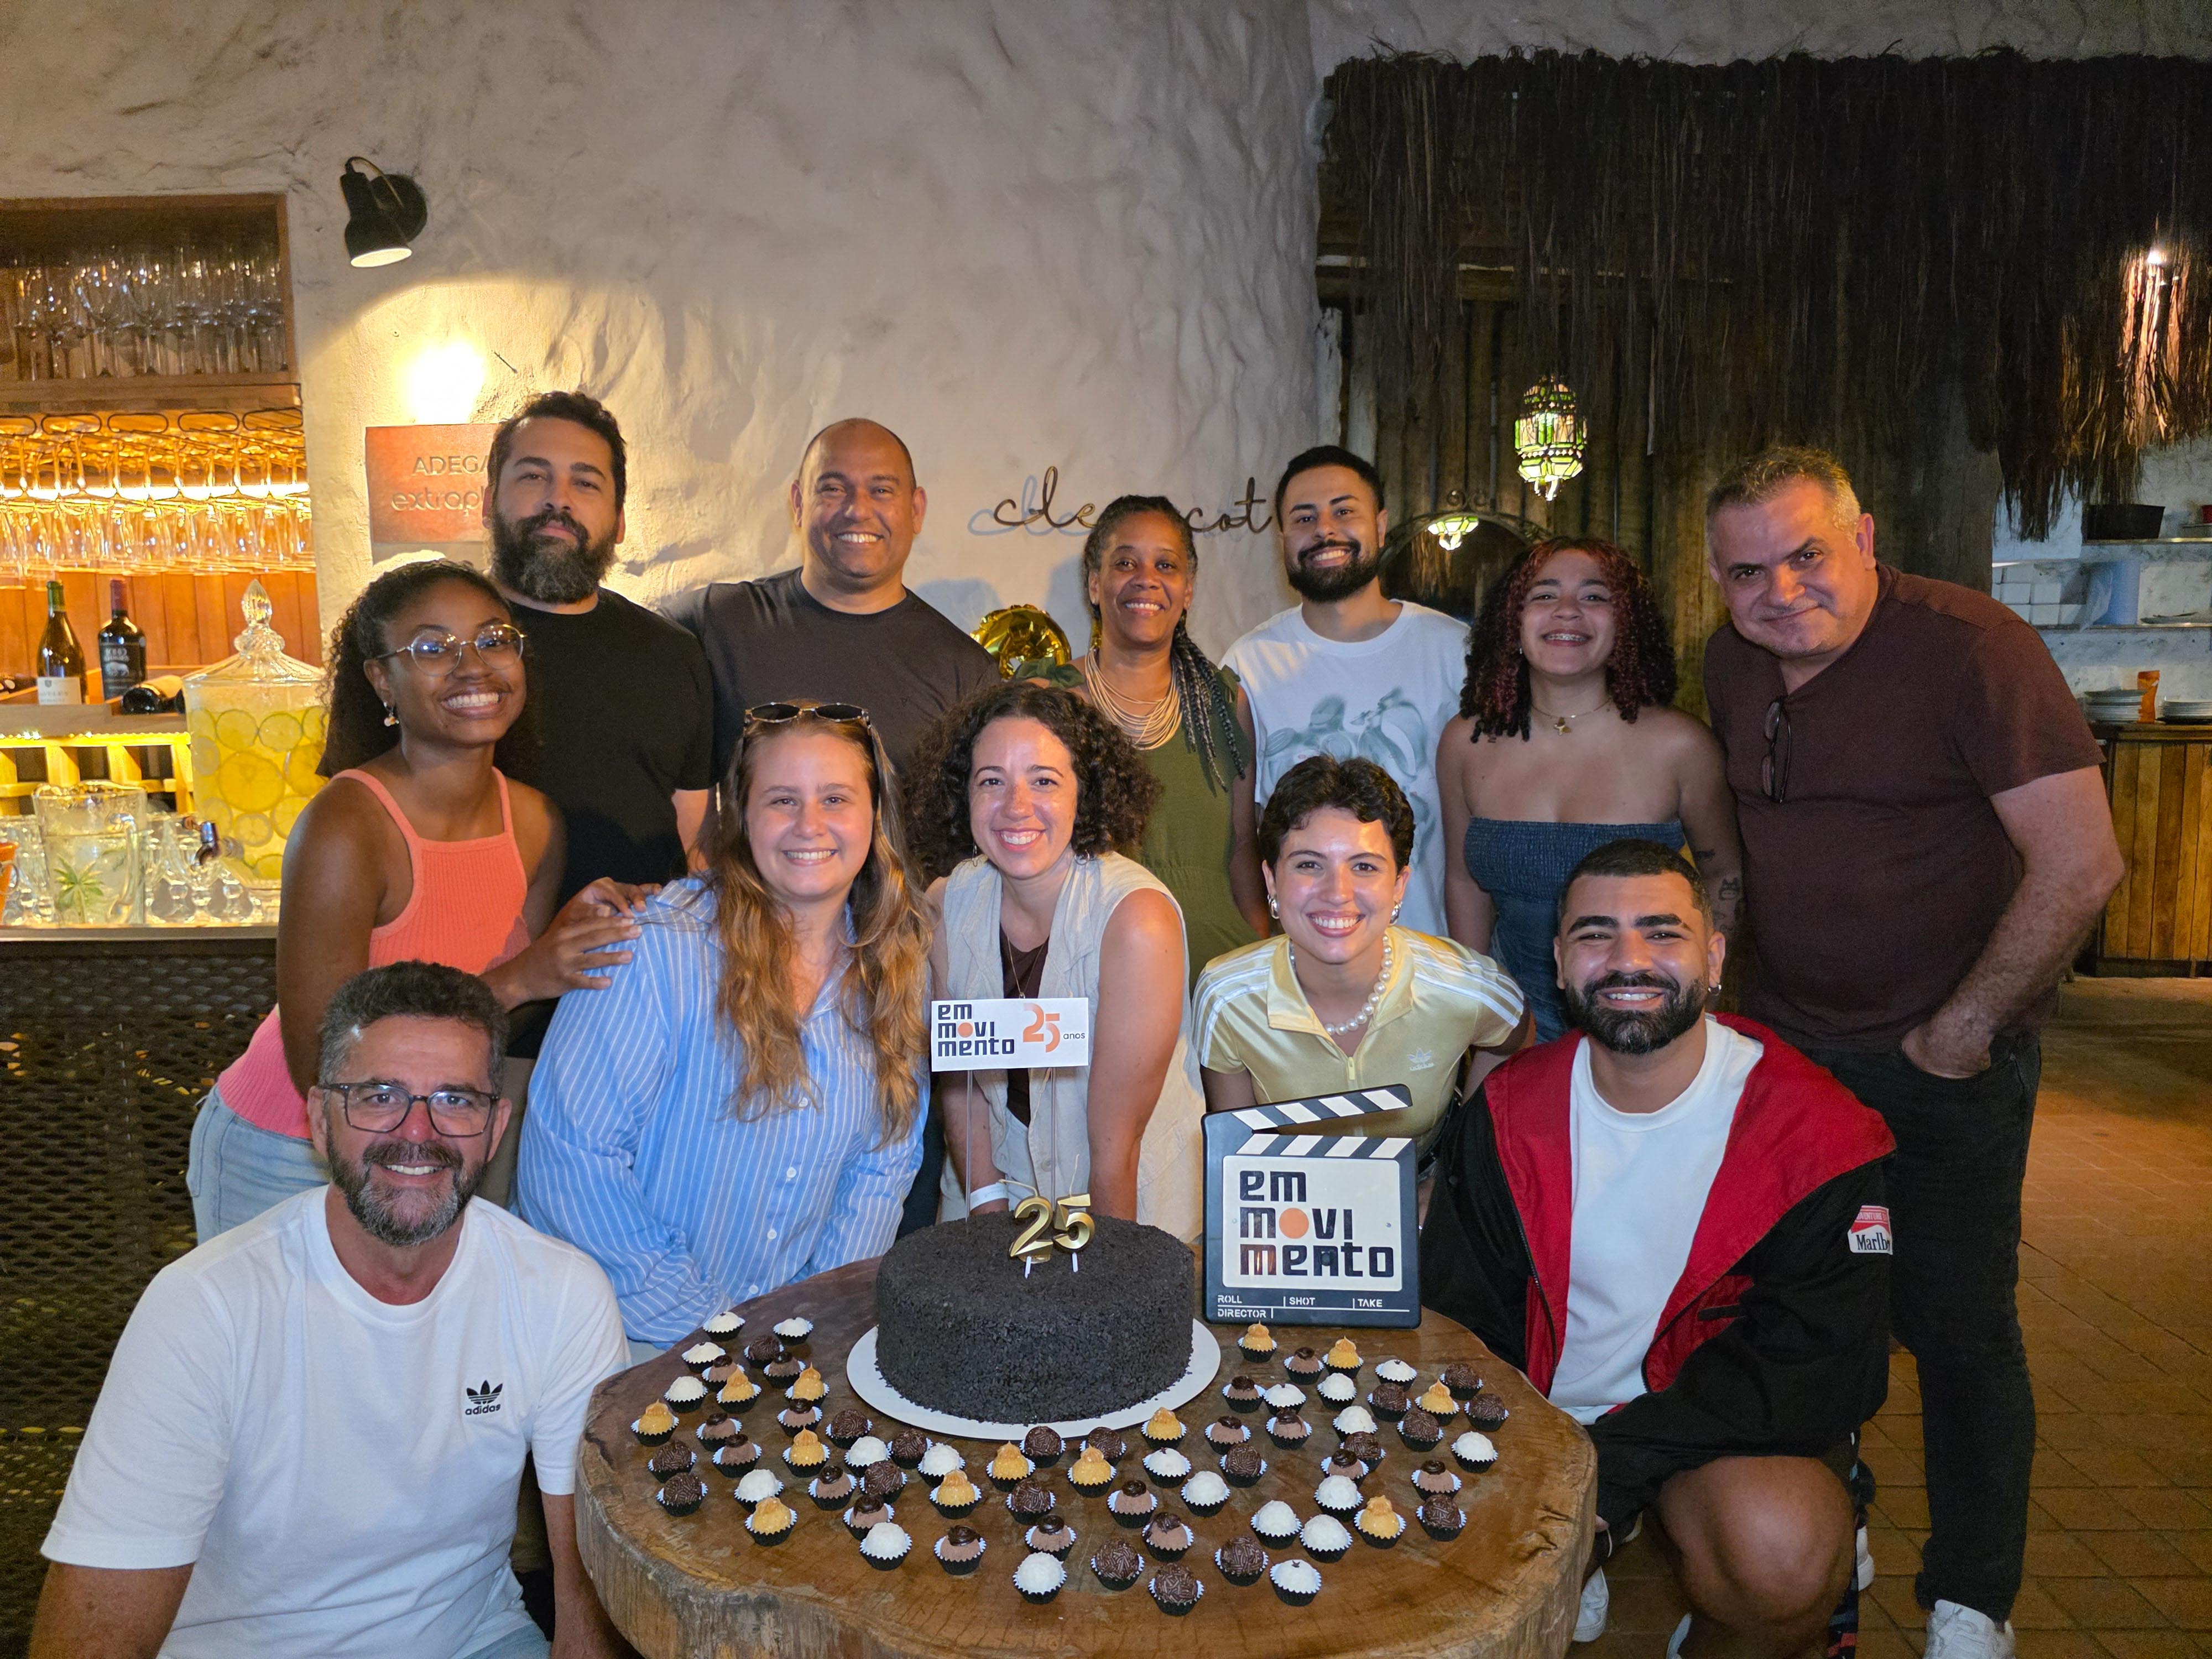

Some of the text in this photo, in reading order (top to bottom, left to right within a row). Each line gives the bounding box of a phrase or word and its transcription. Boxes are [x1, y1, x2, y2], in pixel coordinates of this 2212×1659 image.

[938, 1004, 972, 1020] em
[1022, 1003, 1061, 1053] 25
[938, 1038, 1015, 1057] mento
[1239, 1170, 1307, 1203] em
[1008, 1194, 1095, 1263] 25
[1239, 1241, 1394, 1278] mento
[1217, 1295, 1383, 1308] ROLL SHOT TAKE
[1217, 1308, 1266, 1318] DIRECTOR
[465, 1404, 501, 1415] adidas
